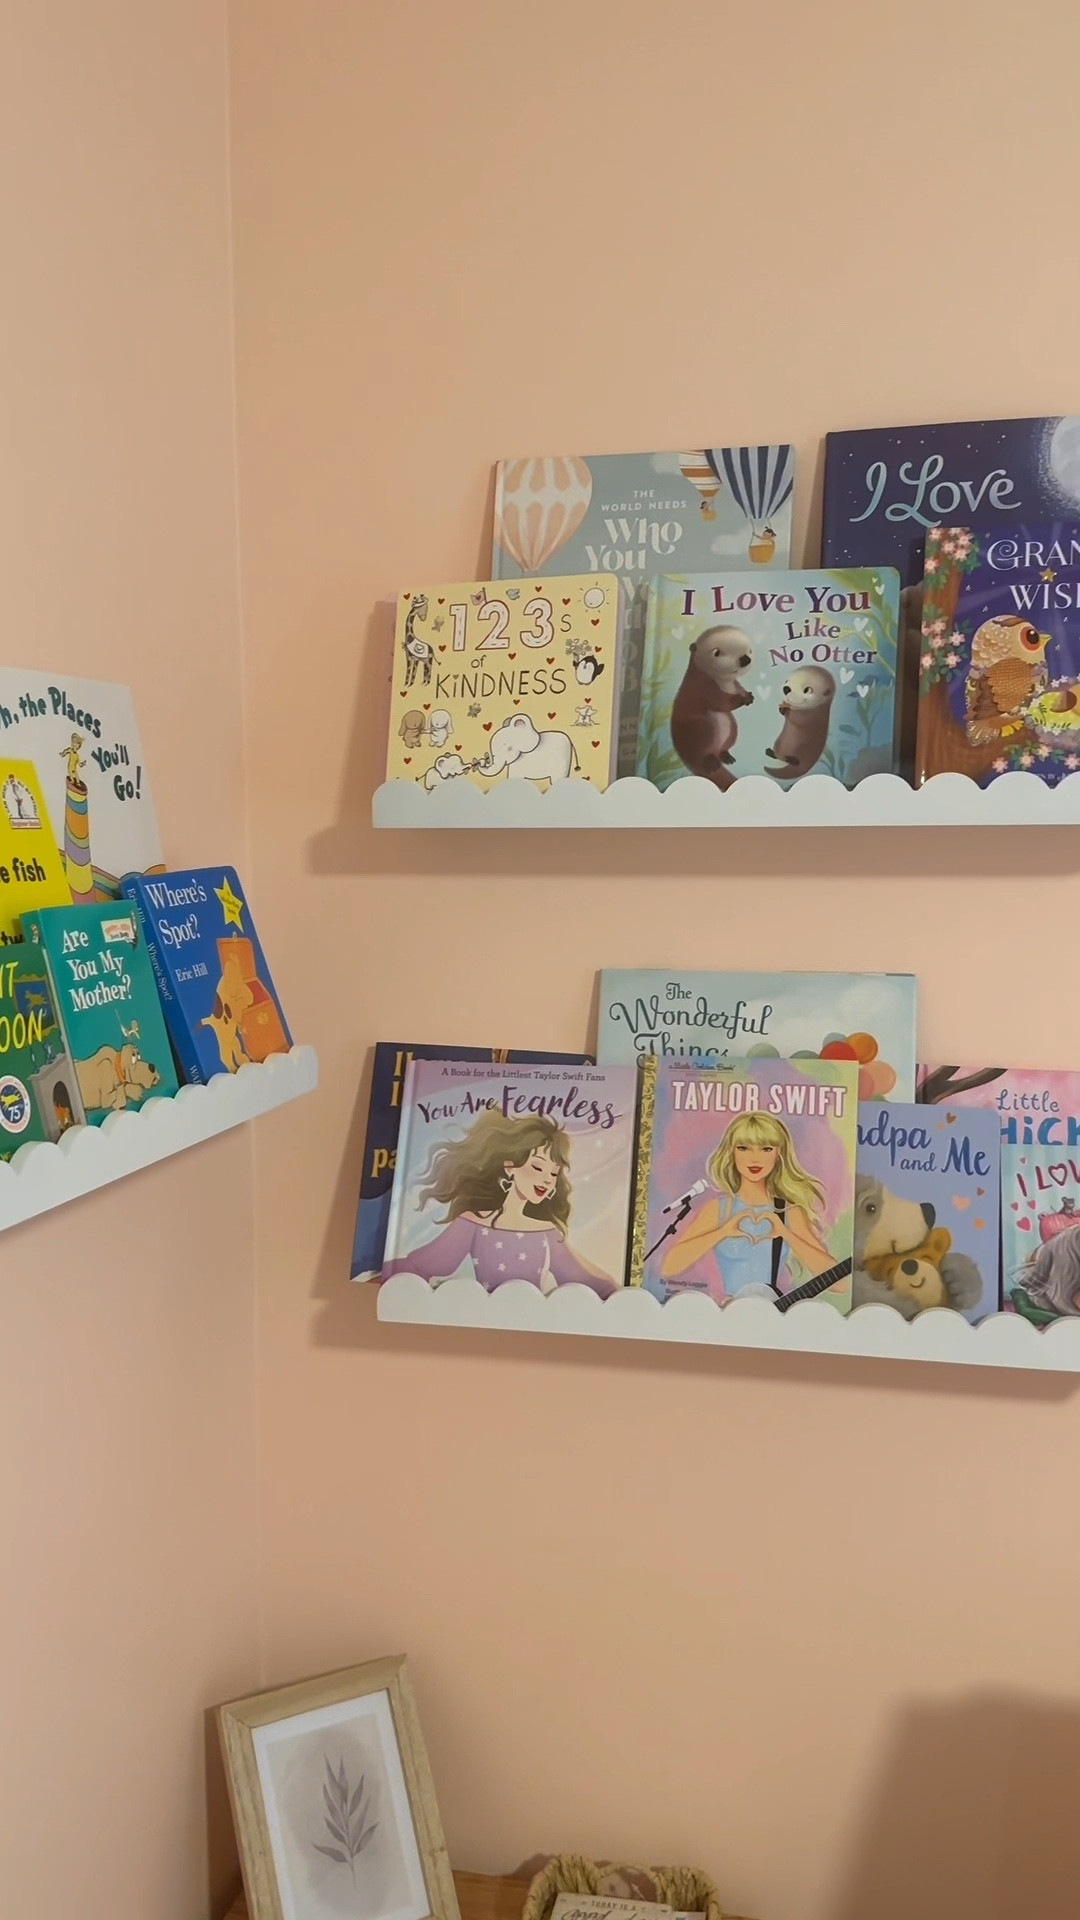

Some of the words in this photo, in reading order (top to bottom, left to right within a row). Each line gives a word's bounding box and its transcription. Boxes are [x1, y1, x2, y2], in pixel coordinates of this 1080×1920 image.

[600, 502, 643, 512] WORLD
[649, 500, 688, 510] NEEDS
[633, 489, 656, 498] THE
[849, 461, 888, 523] I
[885, 454, 1022, 528] Love
[603, 517, 684, 555] Who
[584, 544, 646, 572] You
[681, 589, 696, 616] I
[711, 585, 795, 613] Love
[805, 586, 871, 614] You
[1009, 582, 1080, 611] WIS
[785, 617, 841, 641] Like
[470, 654, 487, 669] of
[768, 645, 804, 667] No
[811, 643, 877, 665] Otter
[18, 692, 47, 718] the
[47, 686, 101, 739] Places
[91, 743, 130, 773] You'll
[113, 765, 142, 801] Go!
[12, 857, 47, 882] fish
[144, 878, 208, 910] Where's
[61, 929, 90, 955] Are
[158, 913, 201, 949] Spot?
[66, 958, 99, 981] You
[97, 949, 124, 977] My
[174, 967, 194, 983] Eric
[192, 962, 209, 978] Hill
[68, 973, 132, 1012] Mother?
[665, 982, 693, 1000] The
[609, 995, 773, 1039] Wonderful
[441, 1068, 449, 1077] A
[450, 1068, 471, 1077] Book
[473, 1068, 485, 1077] for
[487, 1069, 500, 1078] the
[502, 1070, 532, 1079] Littlest
[534, 1071, 560, 1081] Taylor
[562, 1072, 584, 1081] Swift
[586, 1073, 606, 1082] Fans
[418, 1102, 459, 1123] You
[460, 1091, 498, 1115] Are
[502, 1085, 624, 1130] Fearless
[671, 1080, 761, 1113] TAYLOR
[768, 1083, 848, 1118] SWIFT
[996, 1088, 1060, 1112] Little
[900, 1152, 937, 1171] and
[941, 1136, 991, 1176] Me
